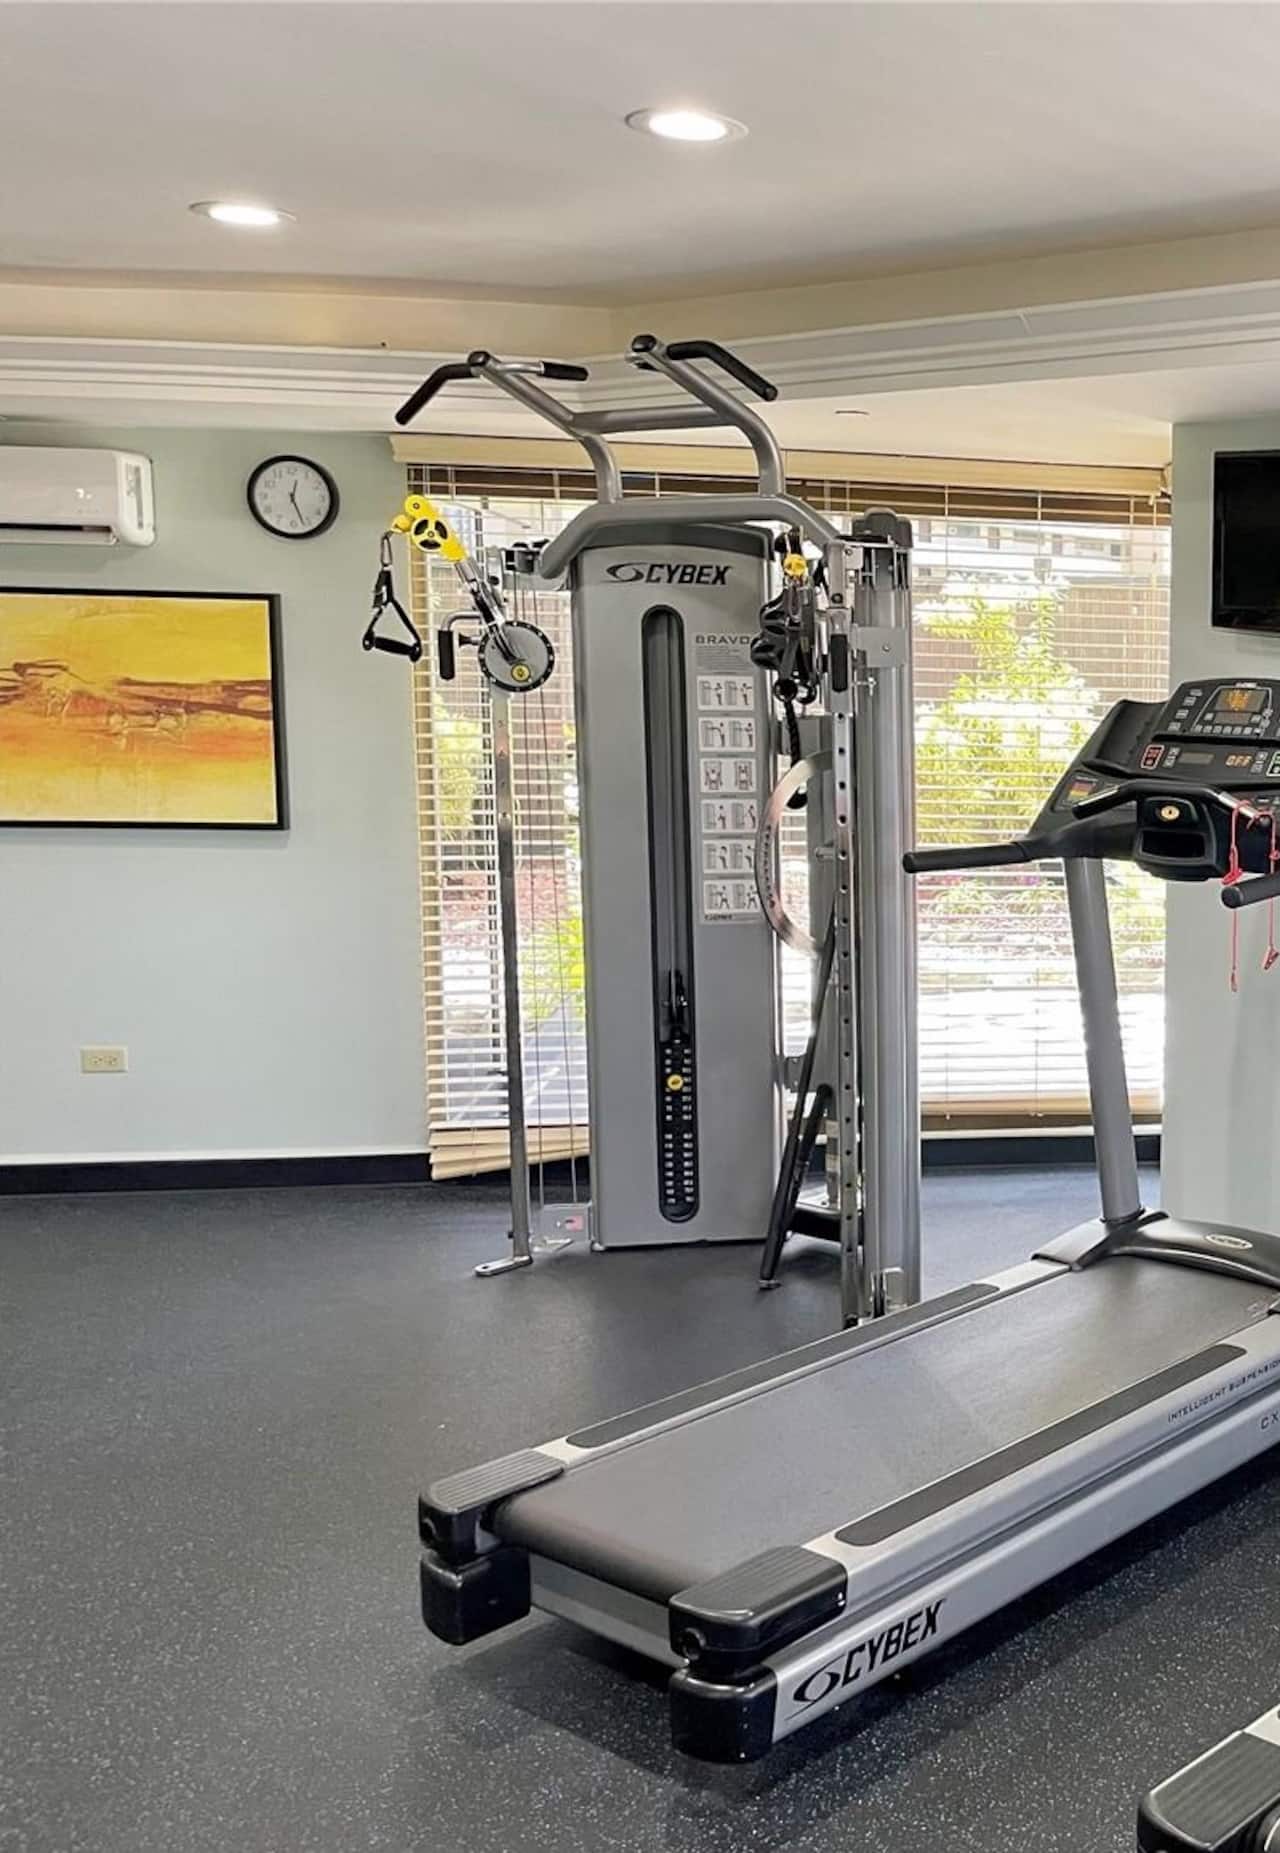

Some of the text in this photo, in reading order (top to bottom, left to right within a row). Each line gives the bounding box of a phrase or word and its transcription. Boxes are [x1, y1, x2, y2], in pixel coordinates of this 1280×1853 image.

[645, 563, 732, 586] CYBEX
[695, 635, 750, 646] BRAVO
[1225, 754, 1253, 767] OFF
[841, 1598, 945, 1688] CYBEX
